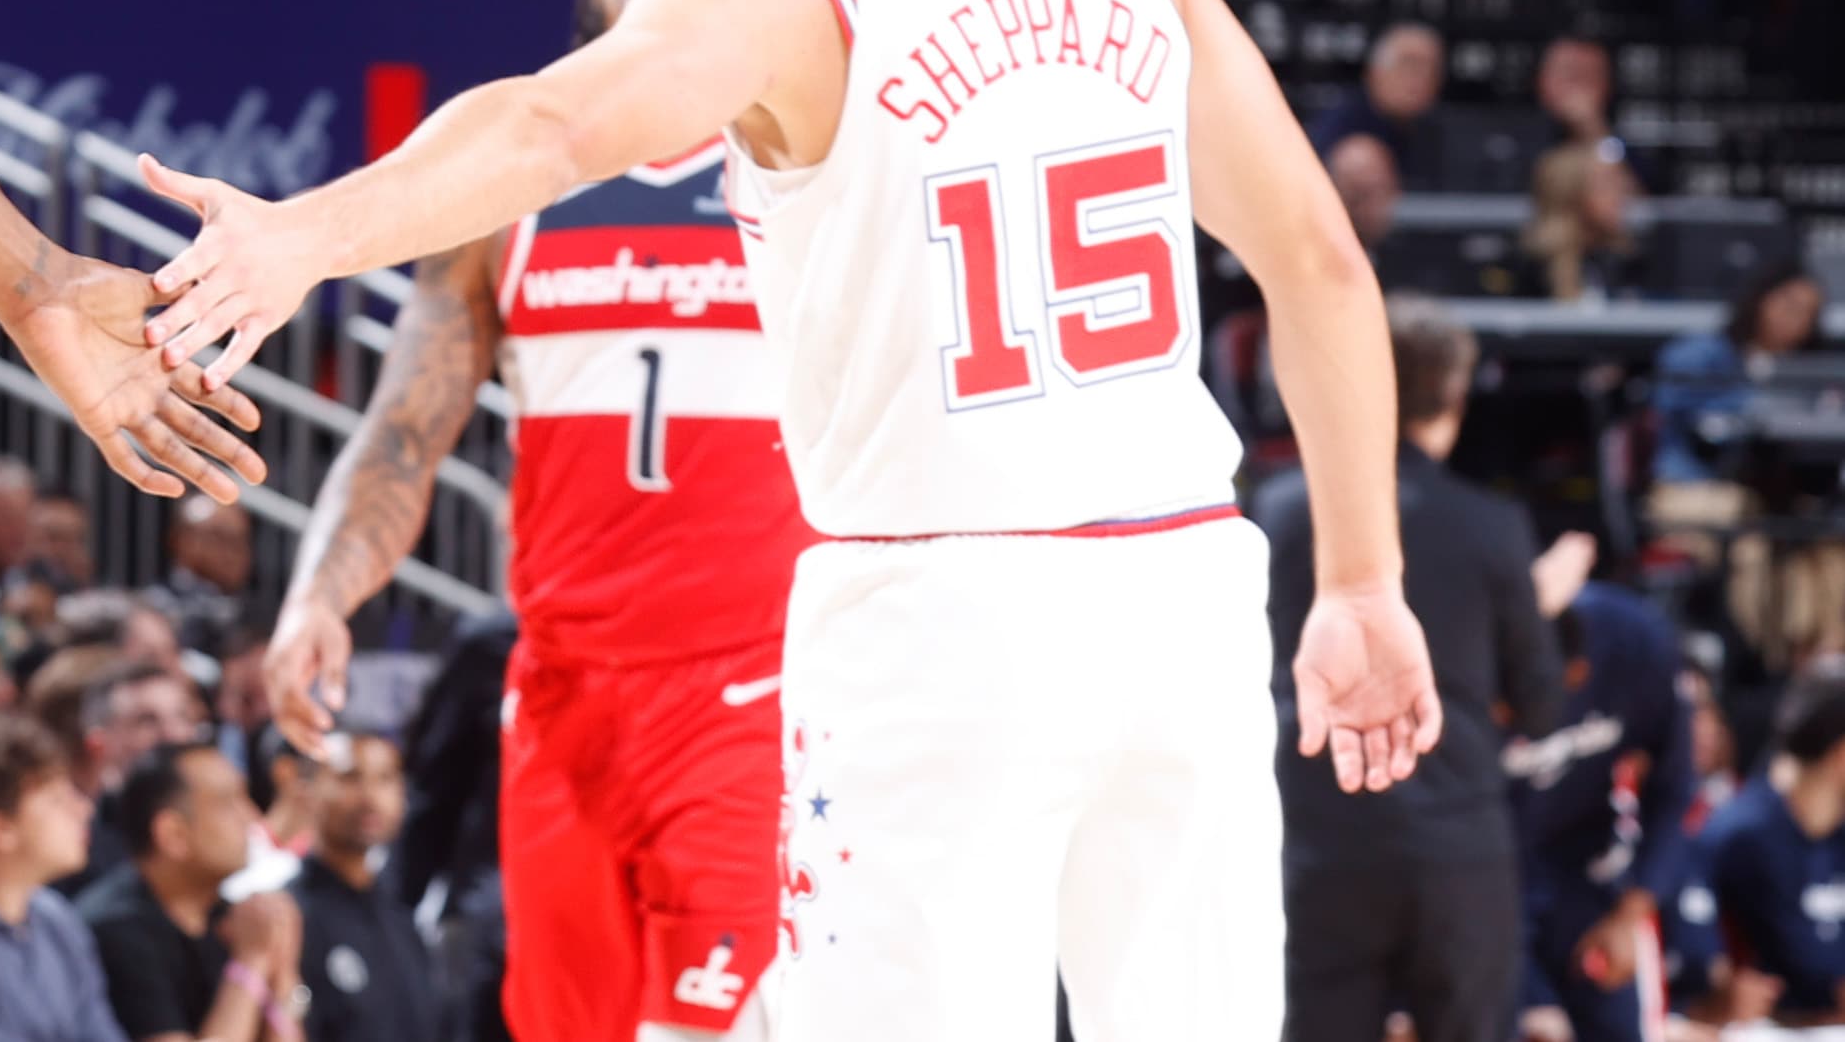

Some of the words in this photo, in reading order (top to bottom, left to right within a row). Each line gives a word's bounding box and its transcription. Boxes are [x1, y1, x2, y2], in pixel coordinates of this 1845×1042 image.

[522, 246, 756, 318] washingto
[924, 129, 1193, 413] 15
[633, 344, 667, 486] 1
